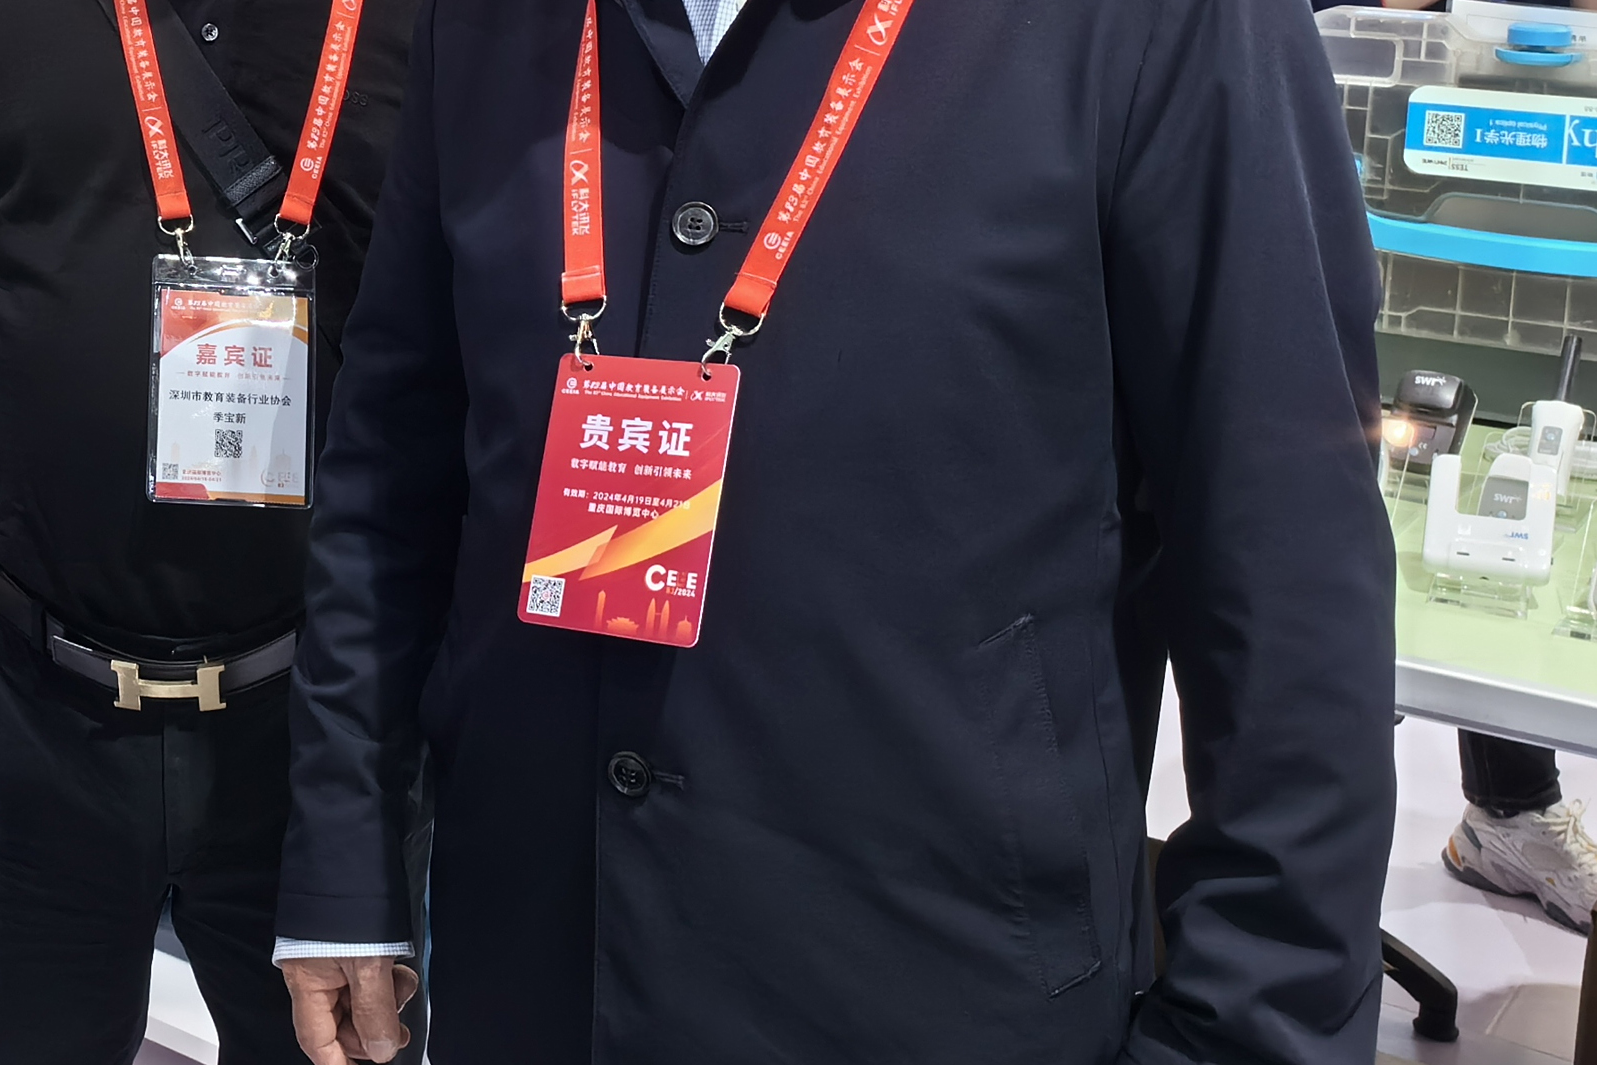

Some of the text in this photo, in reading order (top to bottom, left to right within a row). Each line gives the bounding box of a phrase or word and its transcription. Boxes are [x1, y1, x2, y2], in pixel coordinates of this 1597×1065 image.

[777, 57, 864, 224] 第83届中国教育装备展示会
[311, 155, 323, 179] CEEIA
[775, 231, 795, 260] CEEIA
[196, 343, 273, 368] 嘉宾证
[169, 389, 292, 407] 深圳市教育装备行业协会
[583, 379, 685, 397] 第83届中国教育装备展示会
[579, 413, 694, 457] 贵宾证
[570, 457, 692, 480] 数字赋能教育 创新引领未来
[588, 502, 660, 520] 重庆国际博览中心
